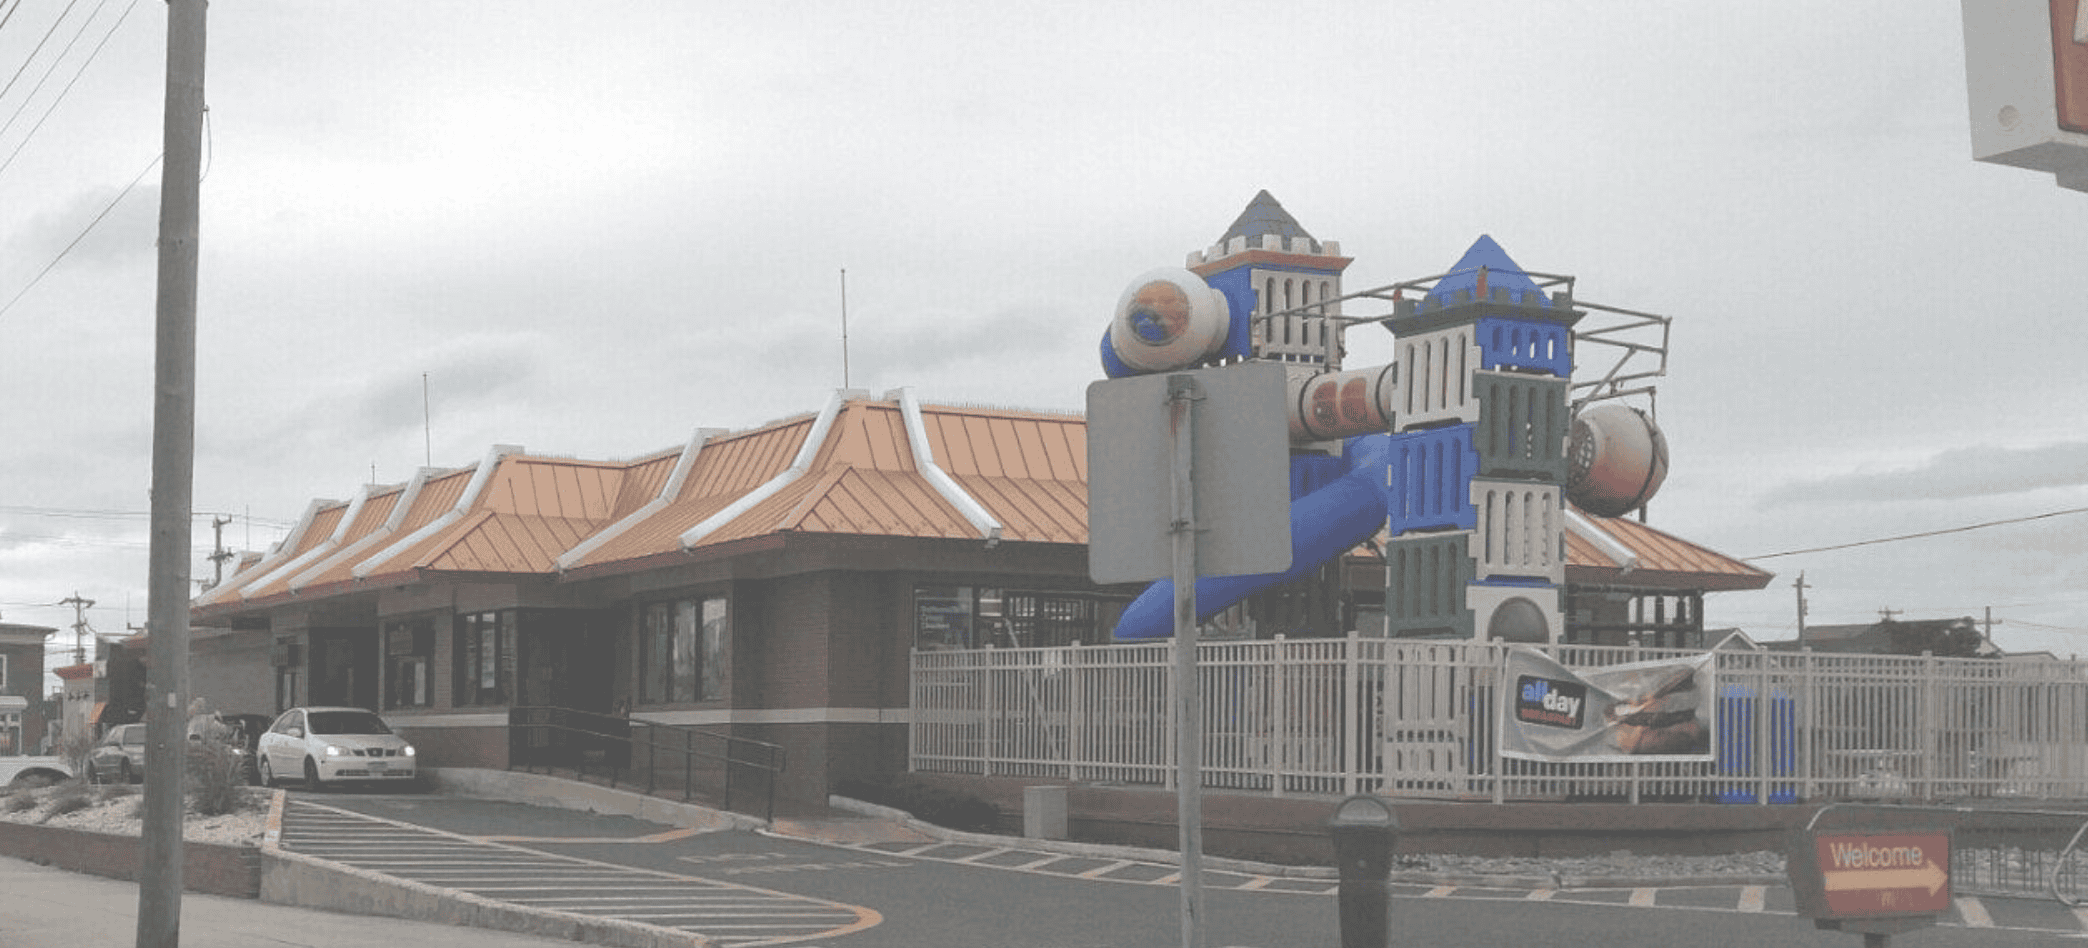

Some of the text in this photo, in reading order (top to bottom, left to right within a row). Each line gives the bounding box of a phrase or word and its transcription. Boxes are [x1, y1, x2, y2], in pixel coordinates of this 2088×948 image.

[1522, 680, 1581, 717] all day
[1829, 841, 1923, 867] Welcome
